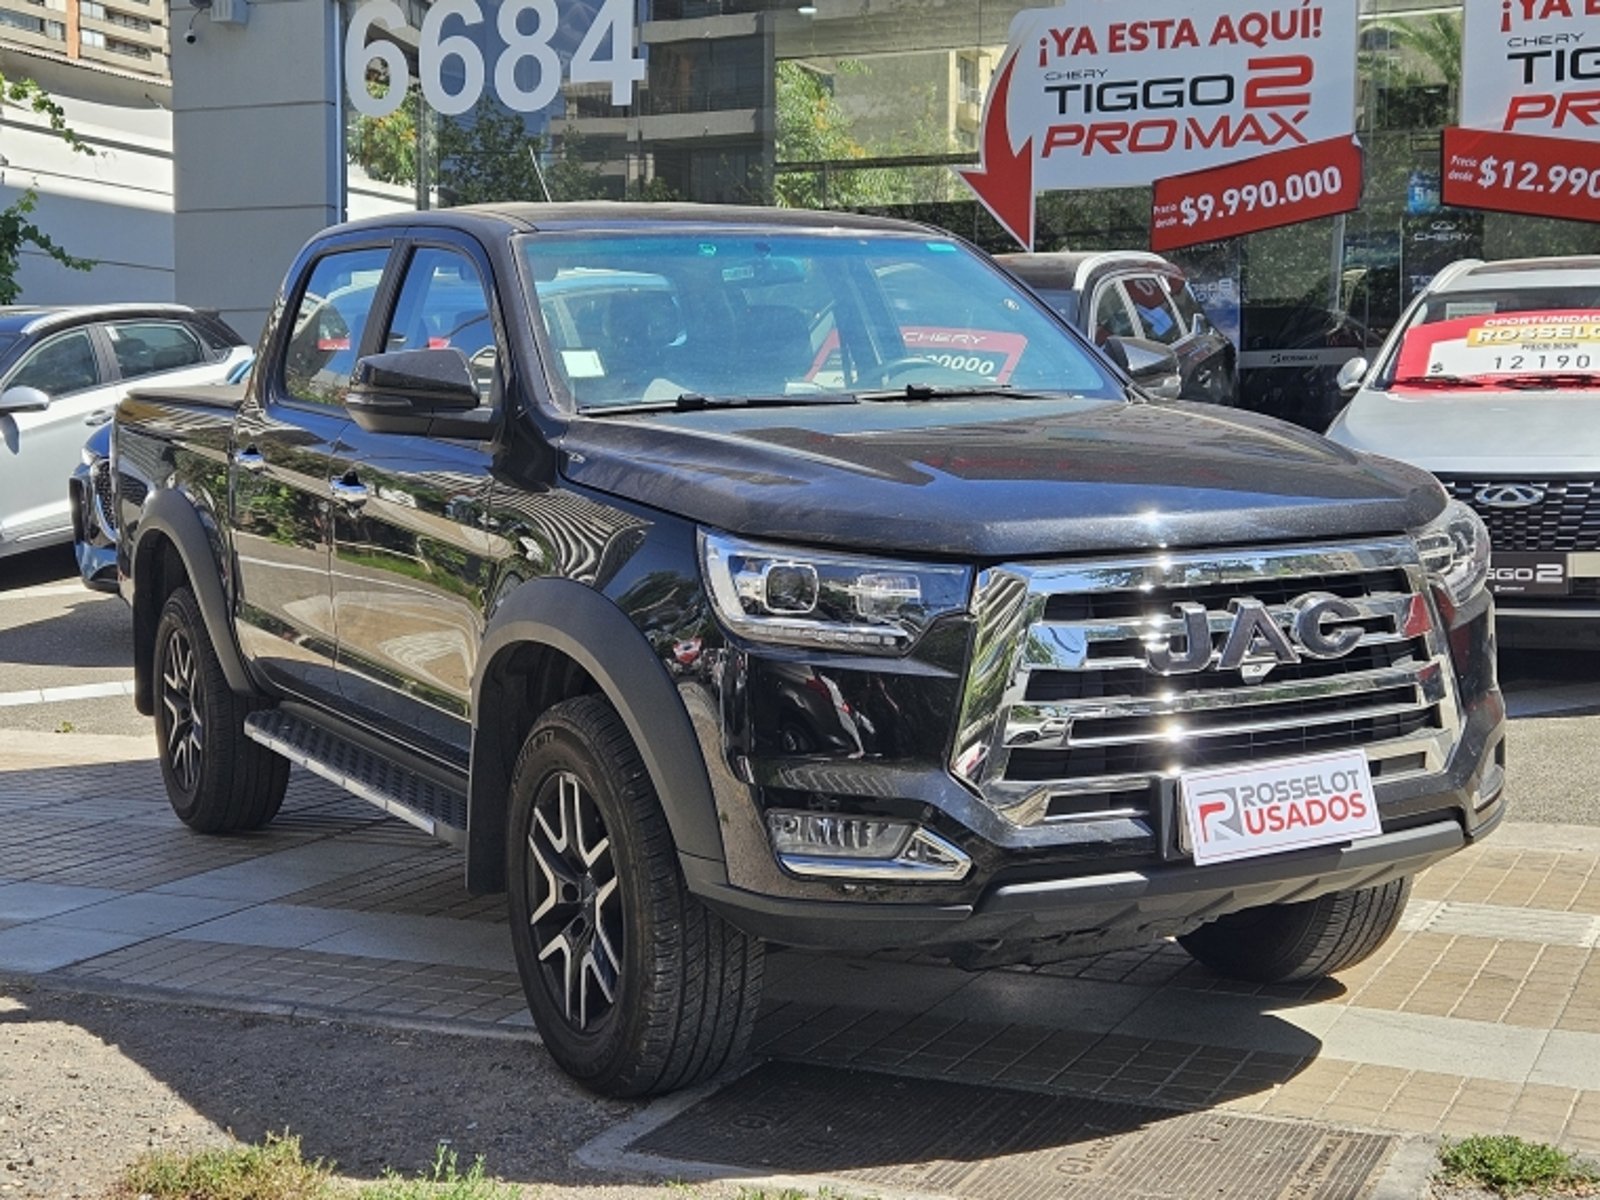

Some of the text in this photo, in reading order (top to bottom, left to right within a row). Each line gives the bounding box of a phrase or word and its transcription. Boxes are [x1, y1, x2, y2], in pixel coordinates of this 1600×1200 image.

[1039, 0, 1323, 67] ¡YA ESTA AQUÍ!
[1507, 32, 1585, 47] CHERY
[345, 0, 645, 117] 6684
[1044, 68, 1109, 81] CHERY
[1044, 54, 1314, 115] TIGGO 2
[1180, 166, 1341, 227] $9.990.000
[903, 331, 987, 344] CHERY
[1536, 563, 1564, 583] 2
[1145, 591, 1366, 676] JAC
[1240, 769, 1359, 807] ROSSELOT
[1244, 793, 1367, 835] USADOS
